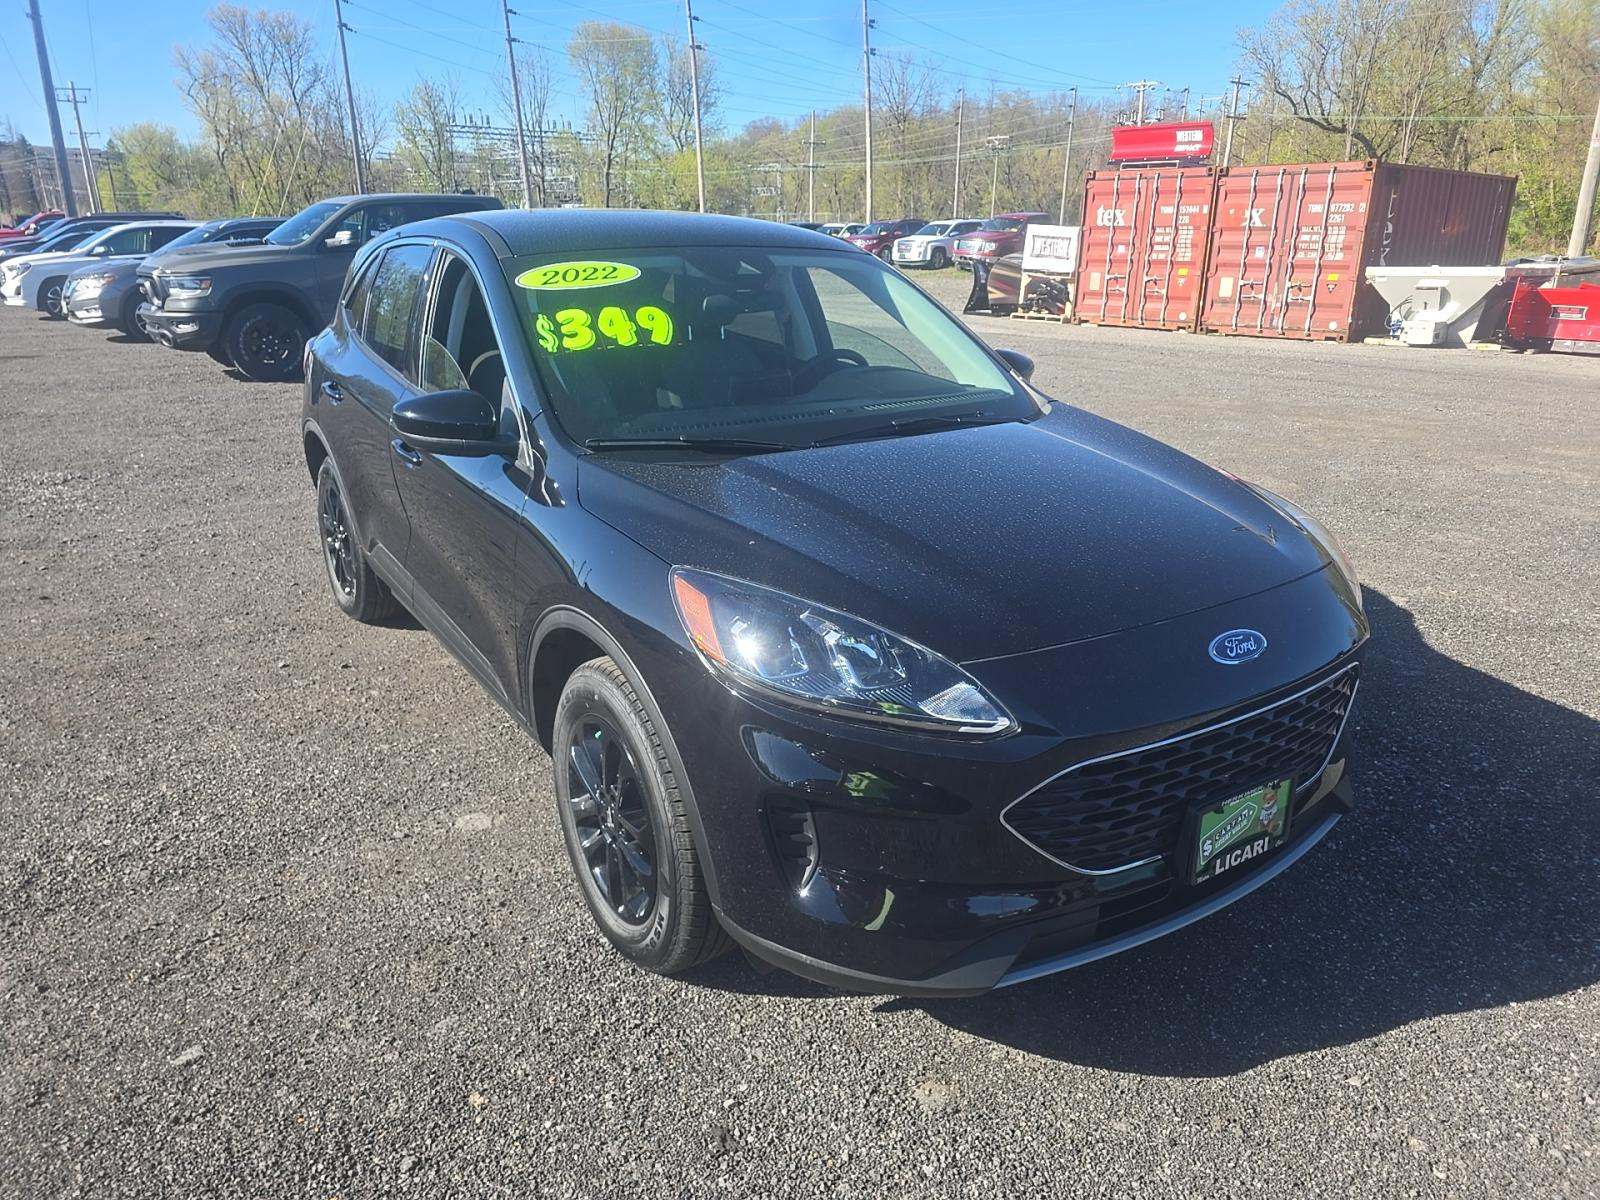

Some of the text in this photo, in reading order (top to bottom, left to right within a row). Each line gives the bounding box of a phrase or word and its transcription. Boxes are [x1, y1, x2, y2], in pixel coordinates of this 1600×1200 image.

[1096, 205, 1126, 227] tex
[541, 266, 618, 286] 2022
[535, 306, 673, 352] $349
[1225, 635, 1257, 657] Ford
[1214, 836, 1270, 876] LICARI
